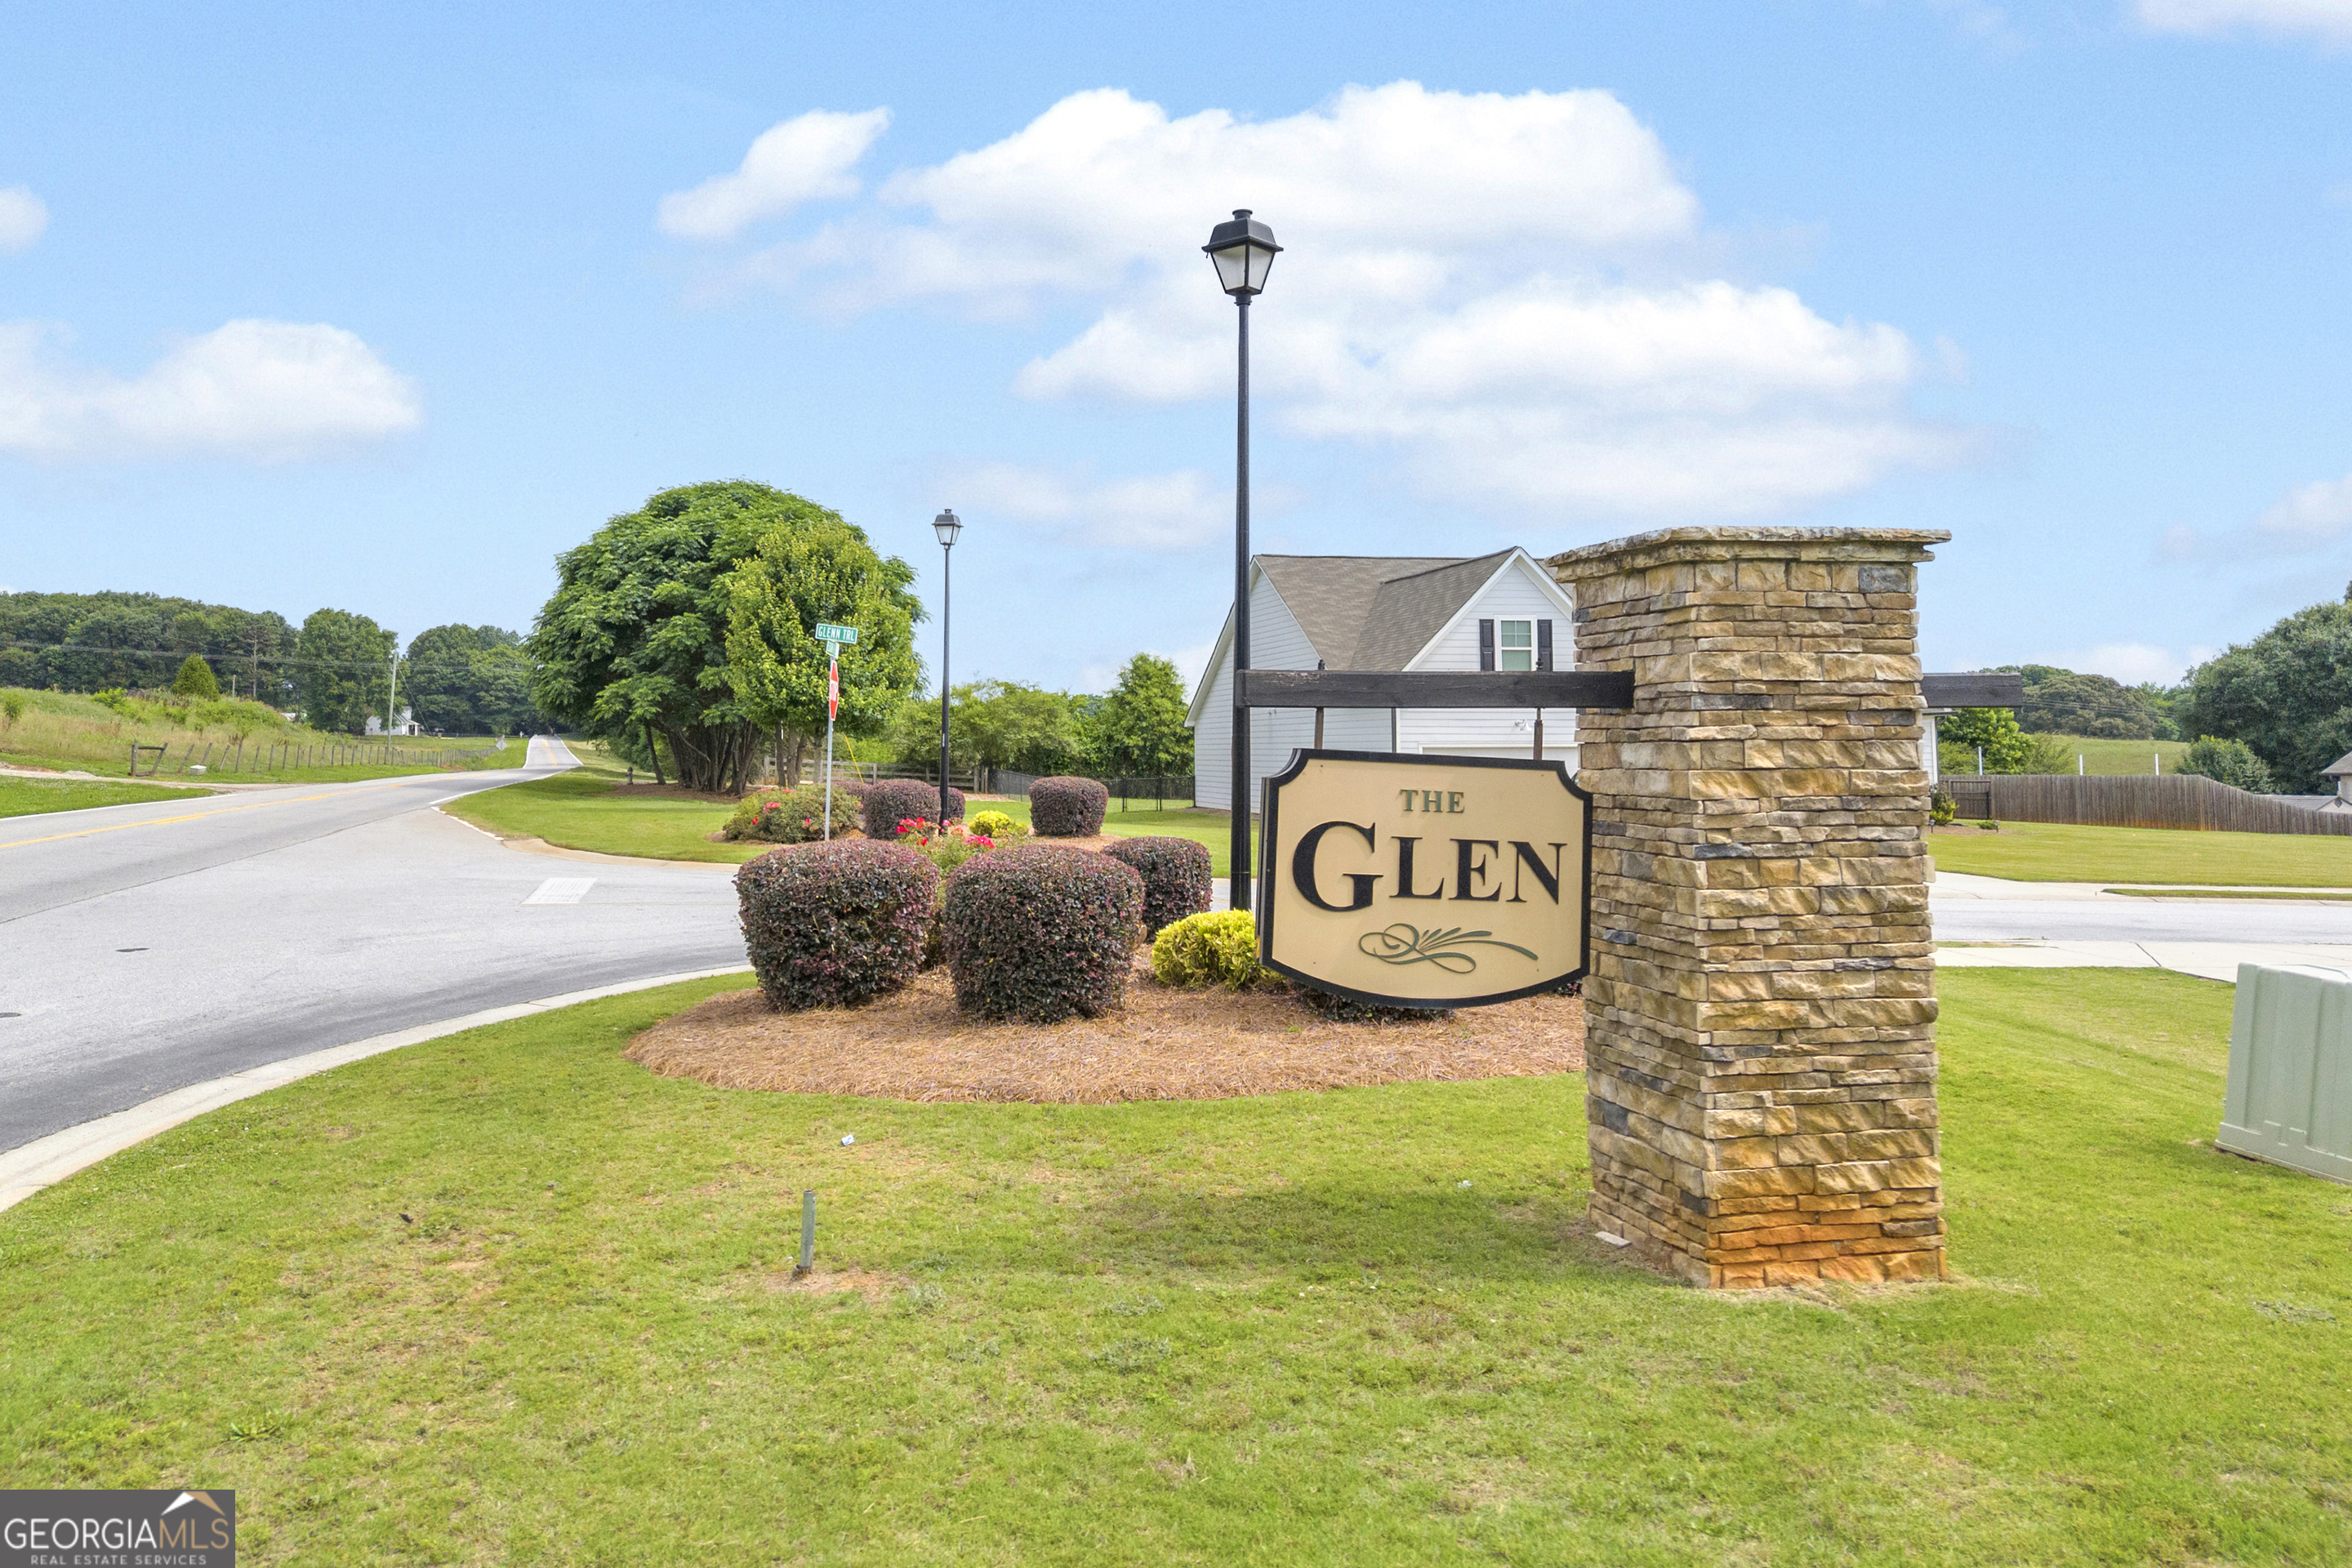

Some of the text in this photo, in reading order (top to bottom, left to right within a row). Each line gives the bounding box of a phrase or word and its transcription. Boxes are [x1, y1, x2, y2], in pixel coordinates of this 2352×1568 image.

[818, 626, 855, 641] GLENN TRL
[1399, 789, 1465, 813] THE
[1292, 820, 1568, 912] GLEN
